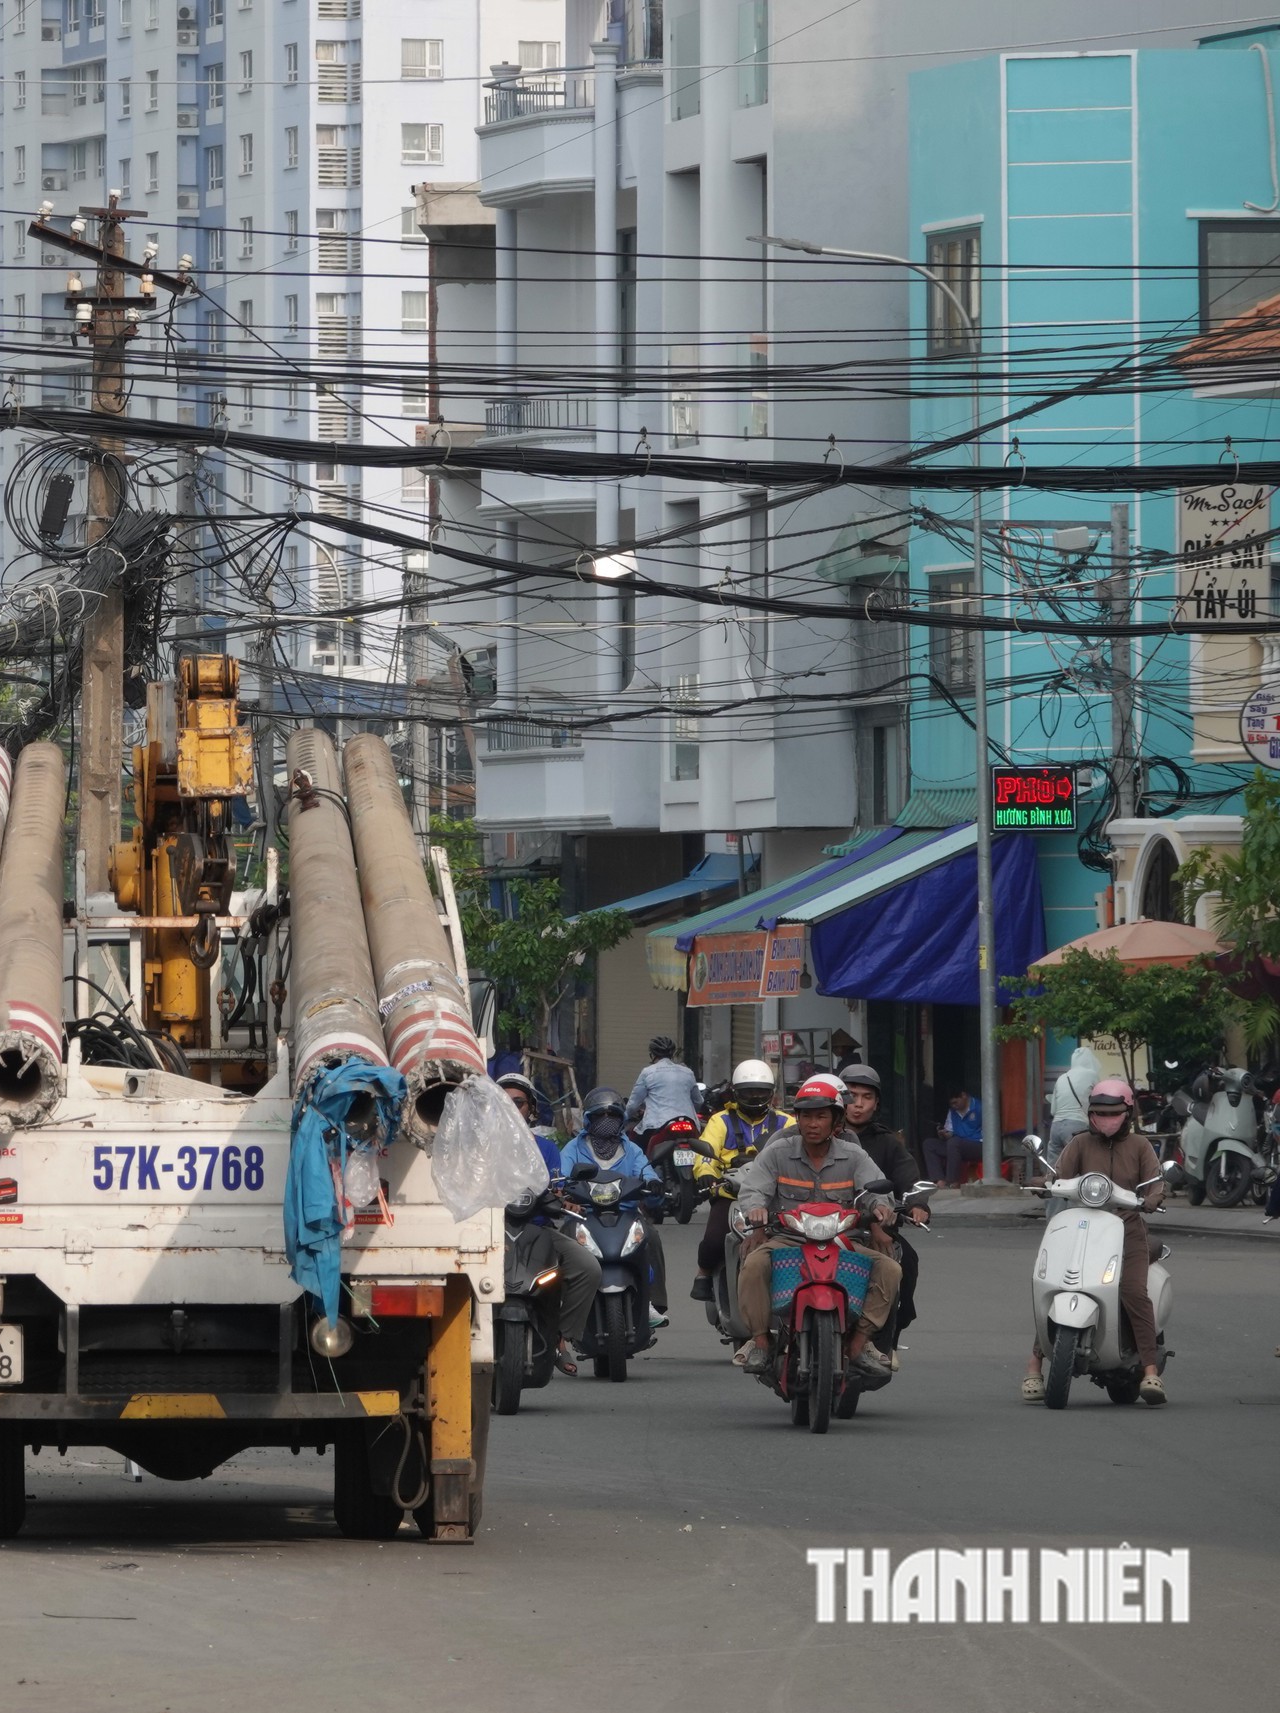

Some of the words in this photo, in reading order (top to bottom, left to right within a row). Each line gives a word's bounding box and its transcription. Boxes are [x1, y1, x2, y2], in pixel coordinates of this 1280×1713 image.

[996, 769, 1057, 803] PHỞ
[996, 808, 1028, 825] HƯƠNG
[1030, 807, 1052, 825] BÌNH
[1054, 808, 1072, 825] XƯA
[93, 1145, 265, 1191] 57K-3768
